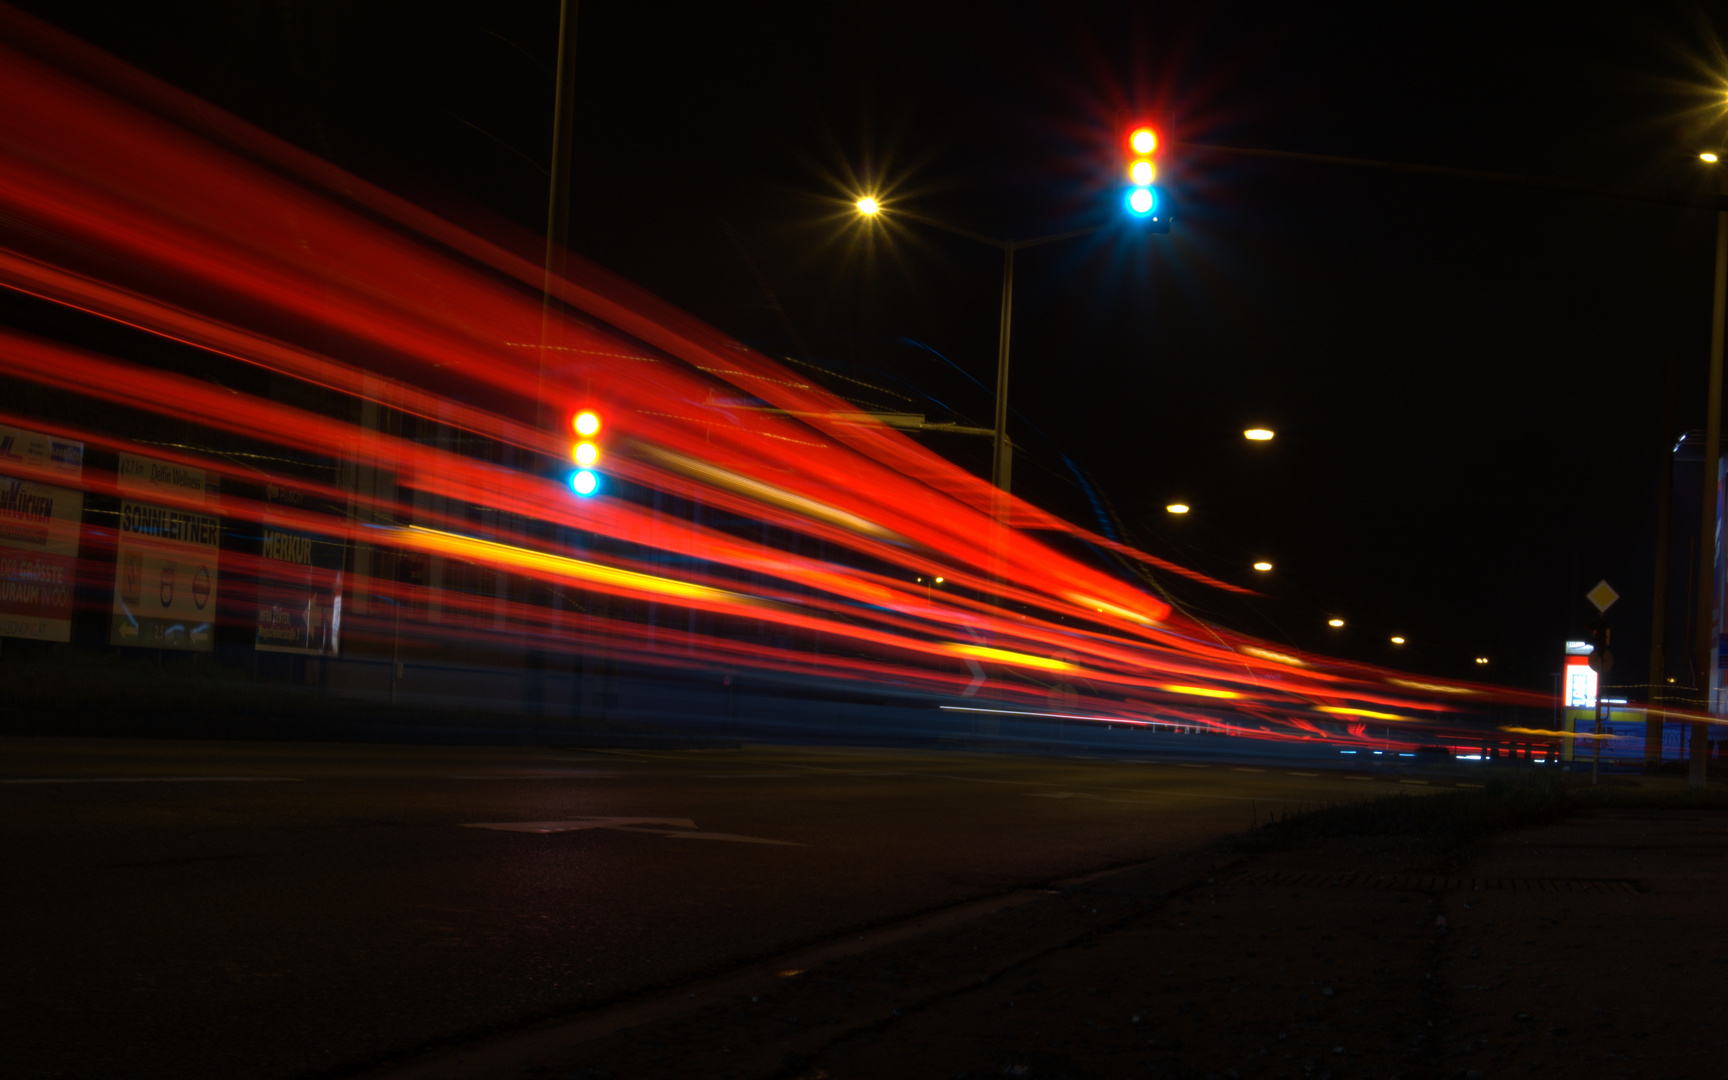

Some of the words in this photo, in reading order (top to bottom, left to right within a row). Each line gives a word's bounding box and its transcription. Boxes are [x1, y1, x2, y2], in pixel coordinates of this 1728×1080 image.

[150, 464, 171, 485] Delfin
[173, 468, 200, 490] Wellness
[123, 504, 217, 545] SONNLEITNER
[262, 530, 312, 565] MERKUR
[0, 559, 17, 578] DER
[19, 559, 64, 585] GRÖSSTE
[0, 581, 39, 604] URAUM
[40, 586, 51, 606] IN
